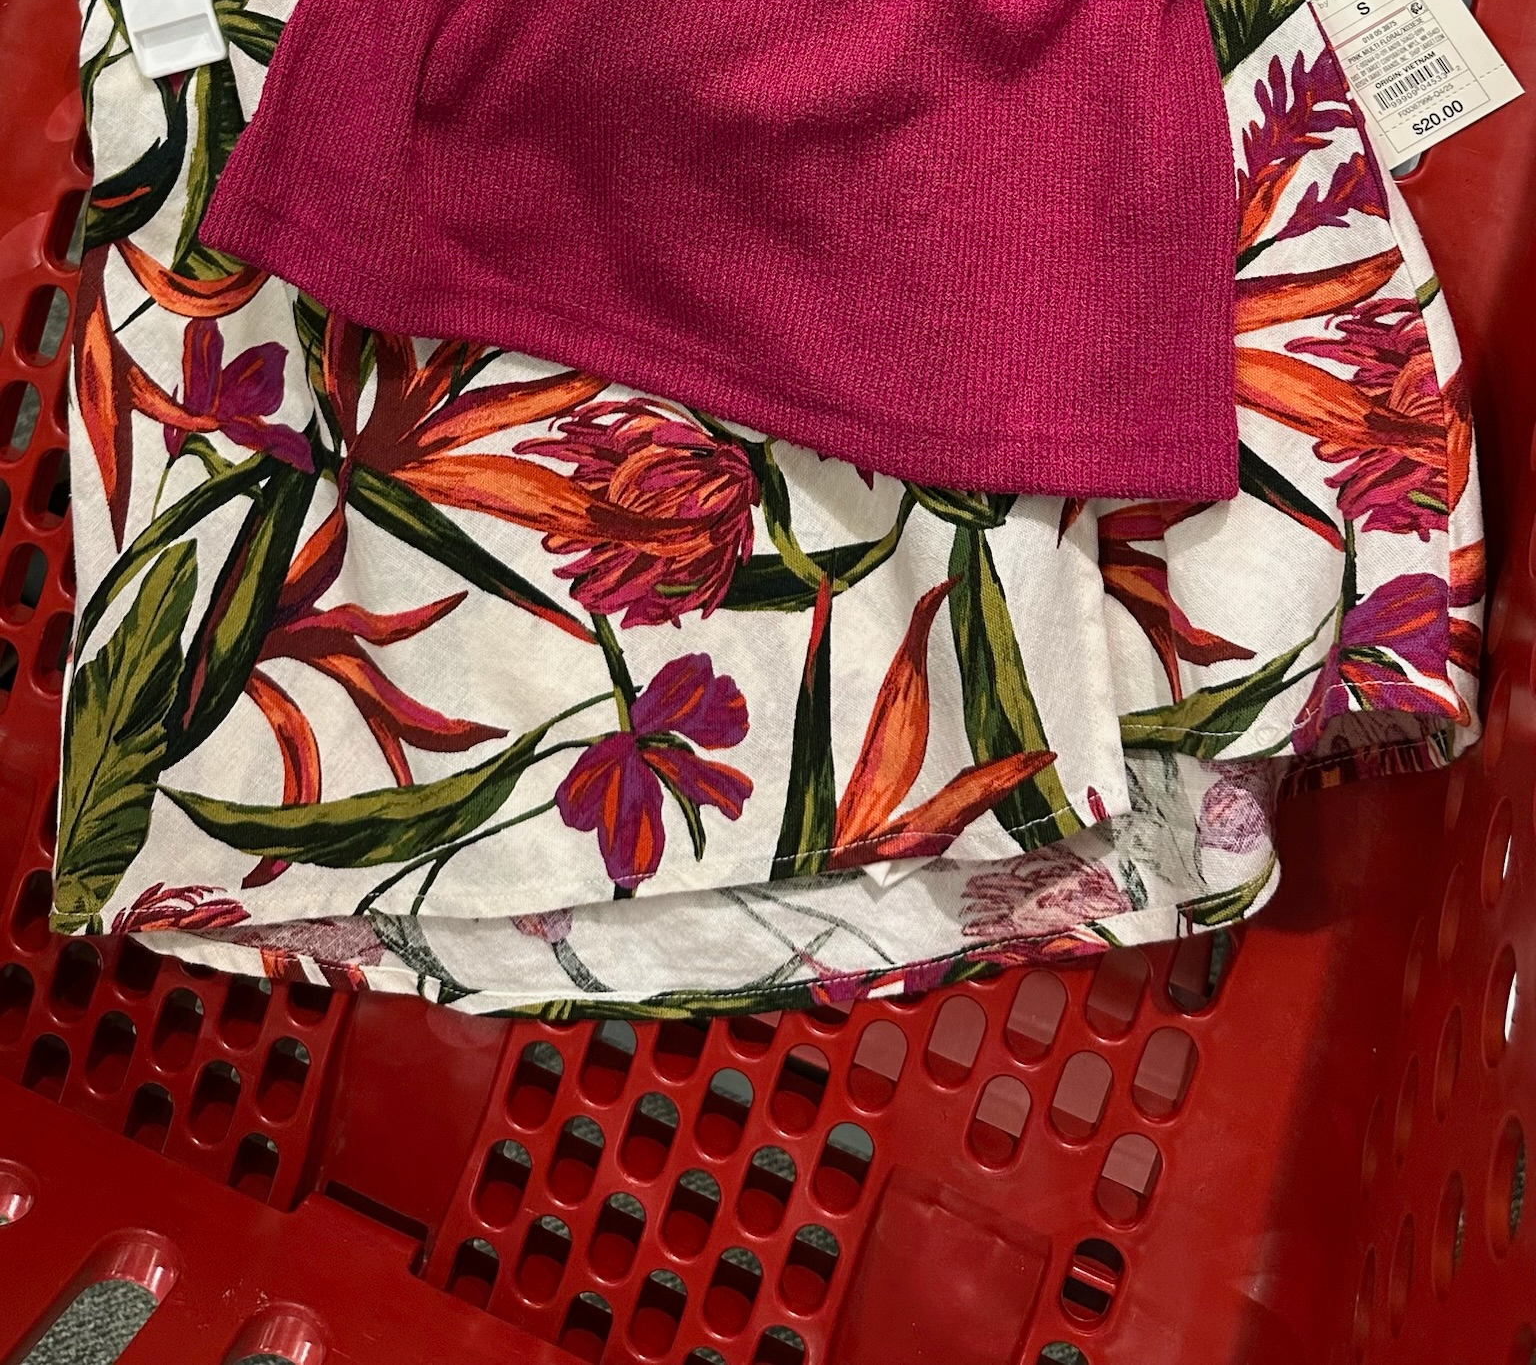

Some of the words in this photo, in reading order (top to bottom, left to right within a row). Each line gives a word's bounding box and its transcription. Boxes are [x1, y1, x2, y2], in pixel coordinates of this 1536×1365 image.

[1356, 0, 1370, 16] S
[1347, 52, 1362, 64] PINK
[1361, 41, 1380, 56] MULTI
[1374, 69, 1402, 89] ORIGIN:
[1402, 50, 1435, 73] VIETNAM
[1412, 99, 1463, 135] $20.00
